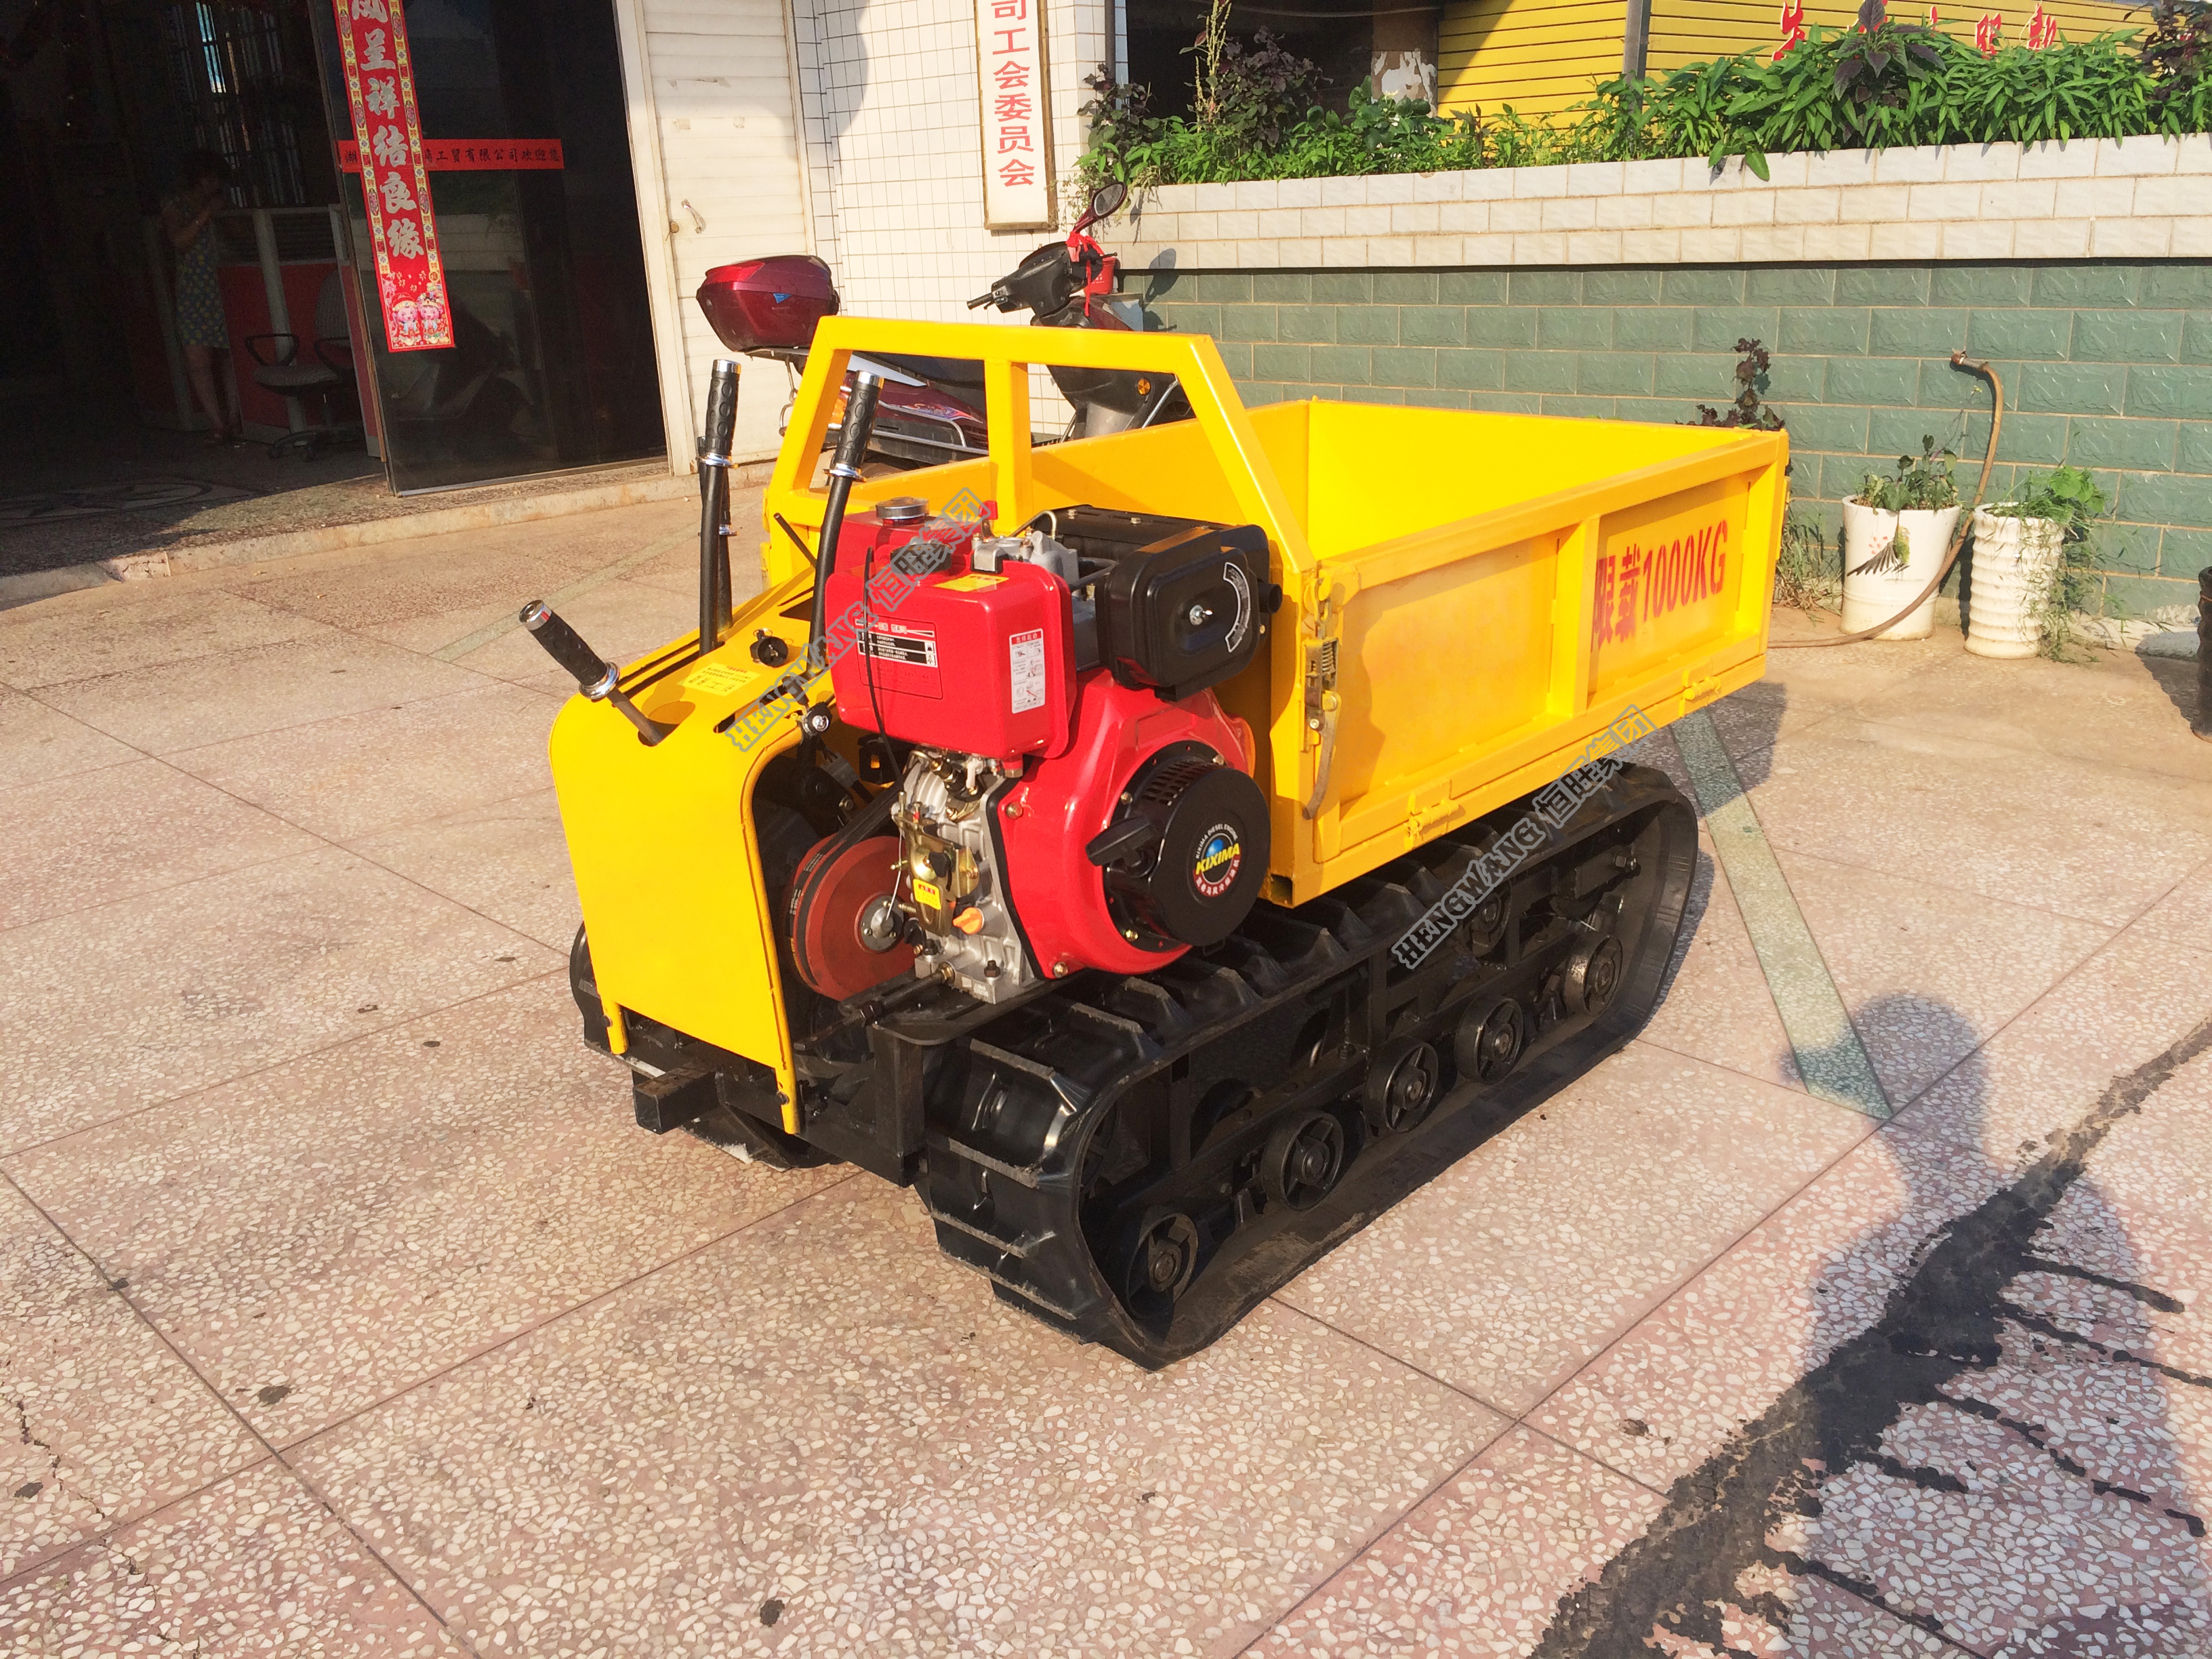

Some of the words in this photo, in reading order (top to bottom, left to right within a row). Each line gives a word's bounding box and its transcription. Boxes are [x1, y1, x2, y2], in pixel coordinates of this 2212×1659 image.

[991, 0, 1036, 187] 司工会委员会
[1195, 842, 1240, 875] KIXIMA
